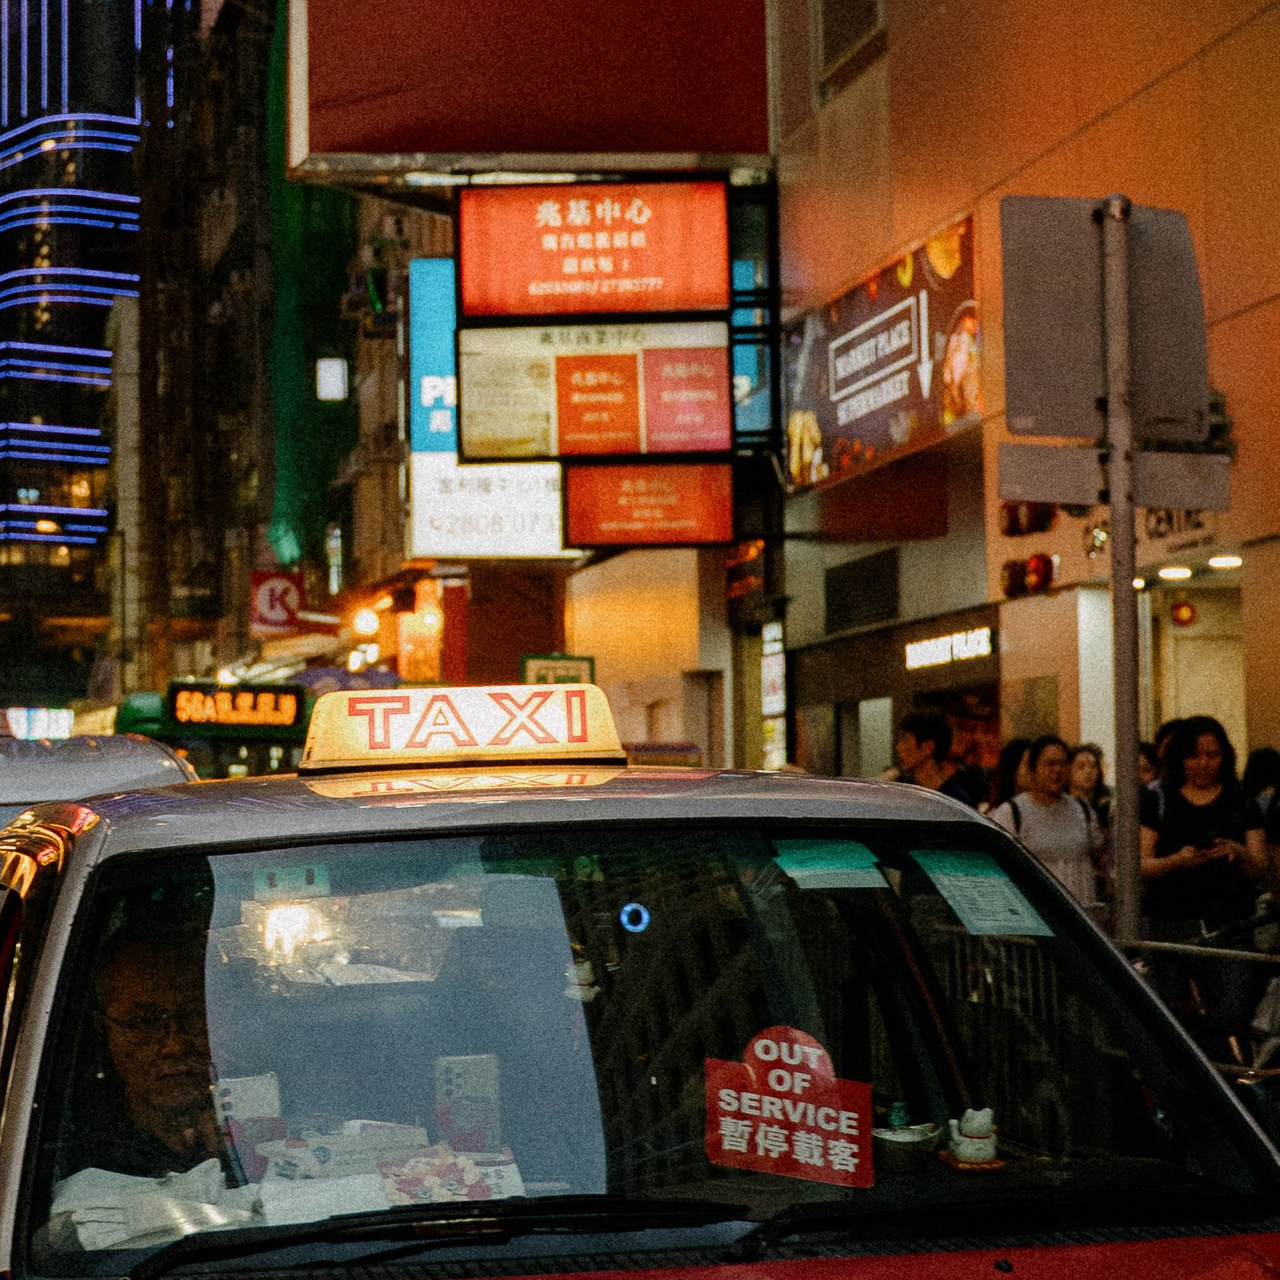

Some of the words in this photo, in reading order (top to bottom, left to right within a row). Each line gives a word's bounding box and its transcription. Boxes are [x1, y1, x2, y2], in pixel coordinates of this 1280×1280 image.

[347, 689, 589, 751] TAXI
[753, 1038, 824, 1070] OUT
[767, 1067, 812, 1094] OF
[718, 1088, 860, 1136] SERVICE
[718, 1116, 861, 1173] 暫停載客
